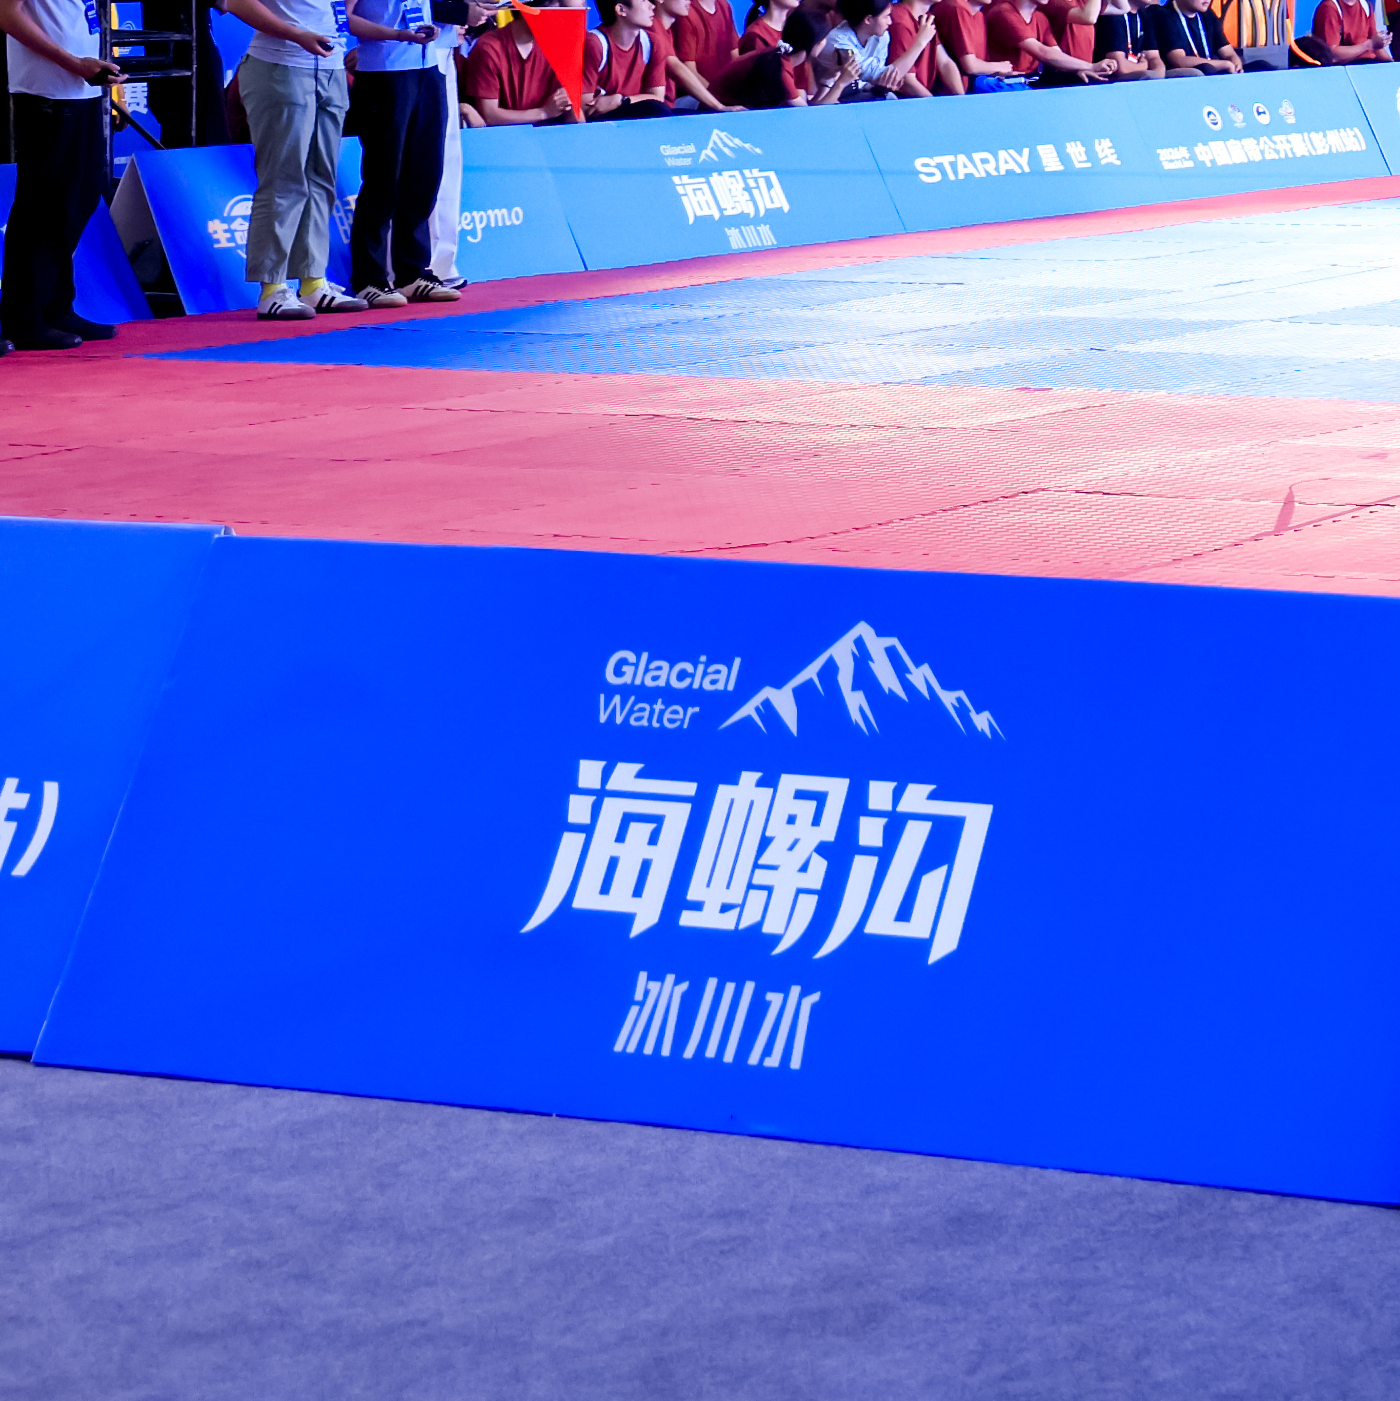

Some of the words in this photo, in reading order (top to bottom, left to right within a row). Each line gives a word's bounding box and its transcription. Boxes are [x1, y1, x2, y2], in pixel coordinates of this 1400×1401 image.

[660, 143, 697, 156] Glacial
[664, 157, 692, 167] Water
[914, 148, 1031, 183] STARAY
[1194, 127, 1366, 167] 中国扁带公开赛(彭州站)
[671, 168, 790, 226] 海螺沟
[457, 206, 523, 243] epmo
[724, 224, 777, 249] 冰川水
[606, 650, 741, 693] Glacial
[597, 693, 699, 731] Water
[520, 759, 993, 965] 海螺沟
[613, 970, 820, 1070] 冰川水
